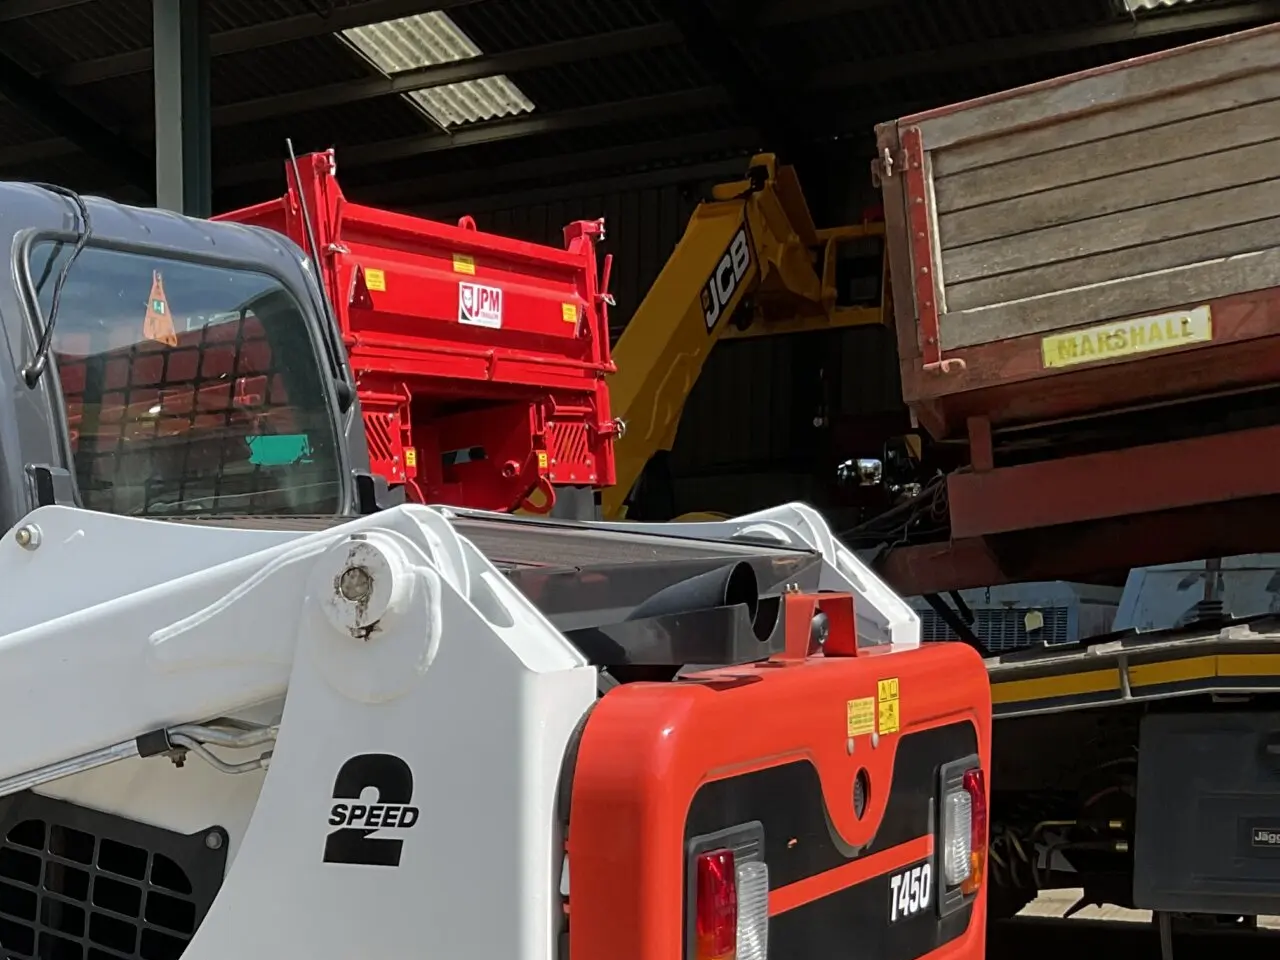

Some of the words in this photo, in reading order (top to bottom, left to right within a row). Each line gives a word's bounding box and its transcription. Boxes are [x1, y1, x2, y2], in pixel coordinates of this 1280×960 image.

[474, 287, 500, 317] JPM
[706, 229, 750, 328] JCB
[1057, 316, 1194, 360] MARSHALL
[322, 753, 414, 868] 2
[328, 803, 420, 828] SPEED
[890, 863, 931, 922] T450
